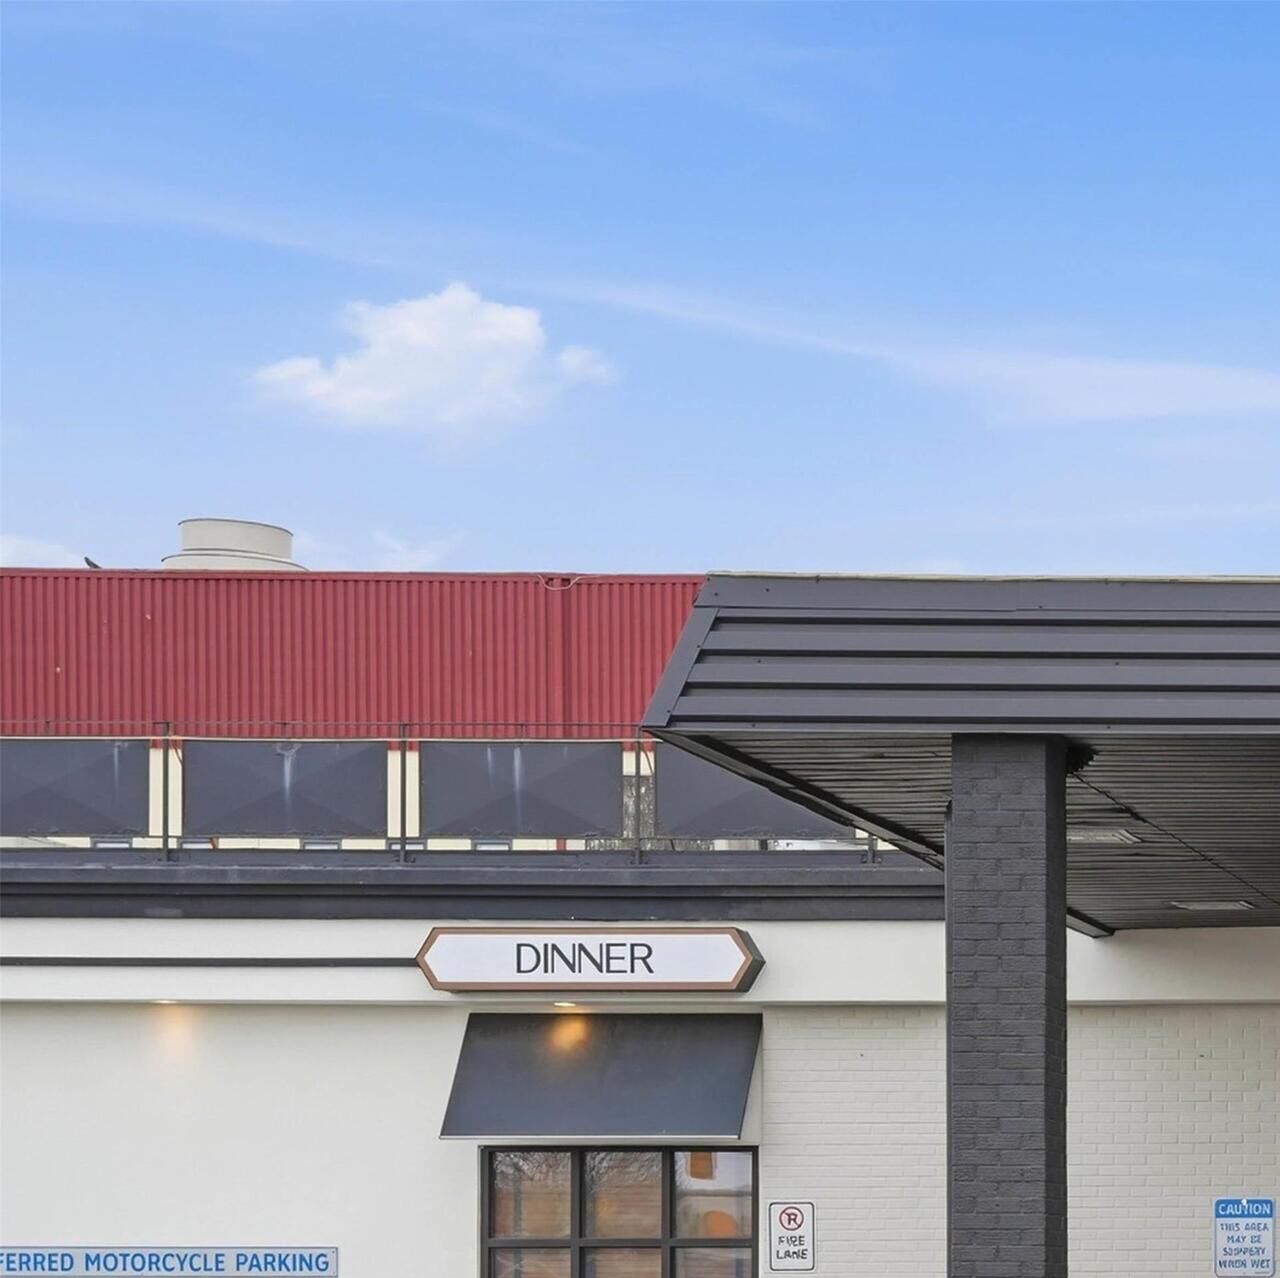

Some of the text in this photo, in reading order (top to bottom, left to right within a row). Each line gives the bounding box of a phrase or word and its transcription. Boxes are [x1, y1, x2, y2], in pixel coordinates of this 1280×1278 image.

[516, 942, 654, 974] DINNER
[1218, 1203, 1271, 1215] CAUTION
[1220, 1222, 1269, 1232] THIS AREA
[778, 1235, 805, 1247] FIRE
[1226, 1234, 1246, 1244] MAY
[776, 1248, 809, 1260] LANE
[84, 1252, 225, 1272] MOTORCYCLE
[235, 1252, 329, 1272] PARKING
